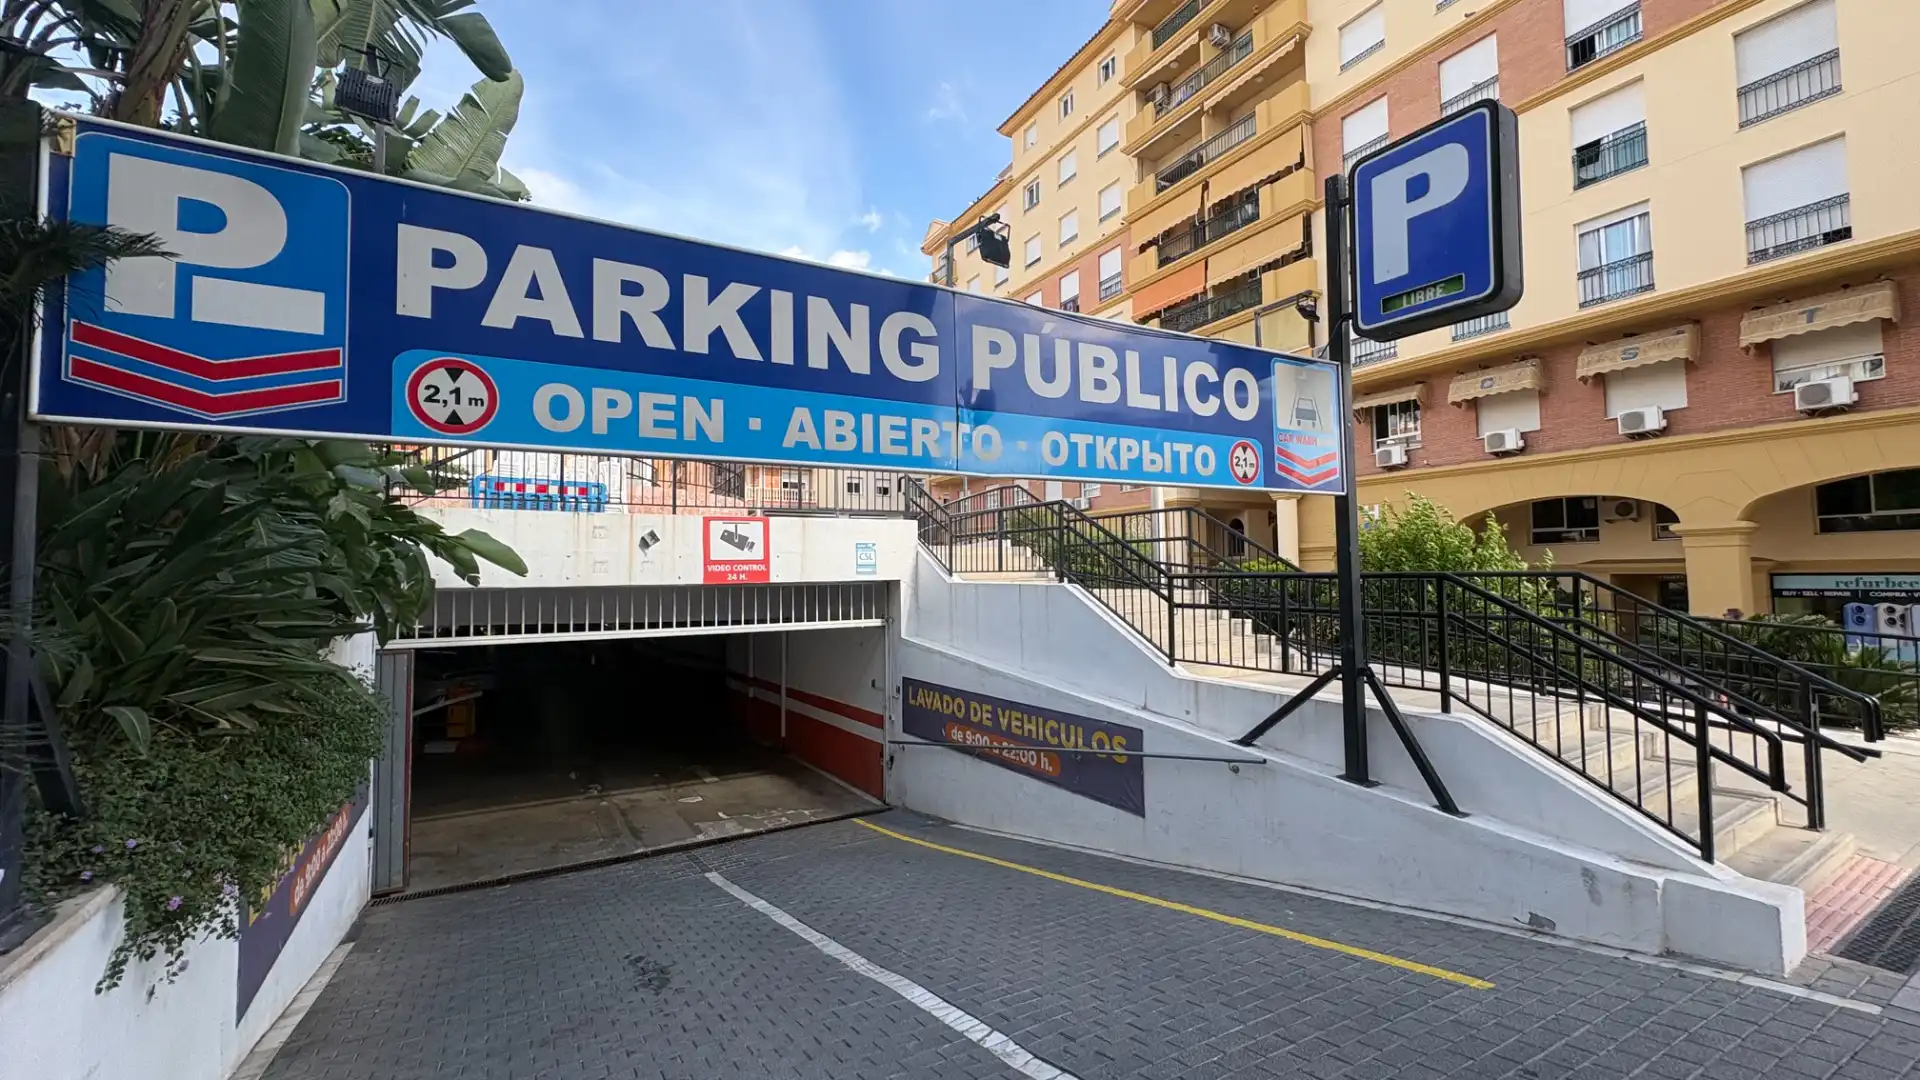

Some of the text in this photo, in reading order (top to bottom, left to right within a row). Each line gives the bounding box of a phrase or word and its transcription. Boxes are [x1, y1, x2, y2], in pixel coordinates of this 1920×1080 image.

[104, 153, 287, 319] P
[1372, 142, 1469, 285] P
[1402, 283, 1446, 307] LIBRE
[396, 224, 1261, 422] PARKING PÚBLICO
[423, 384, 485, 408] 2,1 m
[532, 382, 1003, 463] OPEN ABIERTO
[1295, 434, 1318, 447] WASH
[1041, 431, 1217, 476] ОТКРЫТО
[1234, 455, 1248, 469] 2,1
[706, 564, 767, 572] VIDEO CONTROL
[726, 573, 748, 581] 24 H.
[908, 685, 1128, 764] LAVADO DE VEHICULOS
[951, 726, 963, 742] de
[965, 731, 990, 751] 9:00
[1002, 741, 1037, 766] 22:00
[1040, 752, 1053, 772] h.
